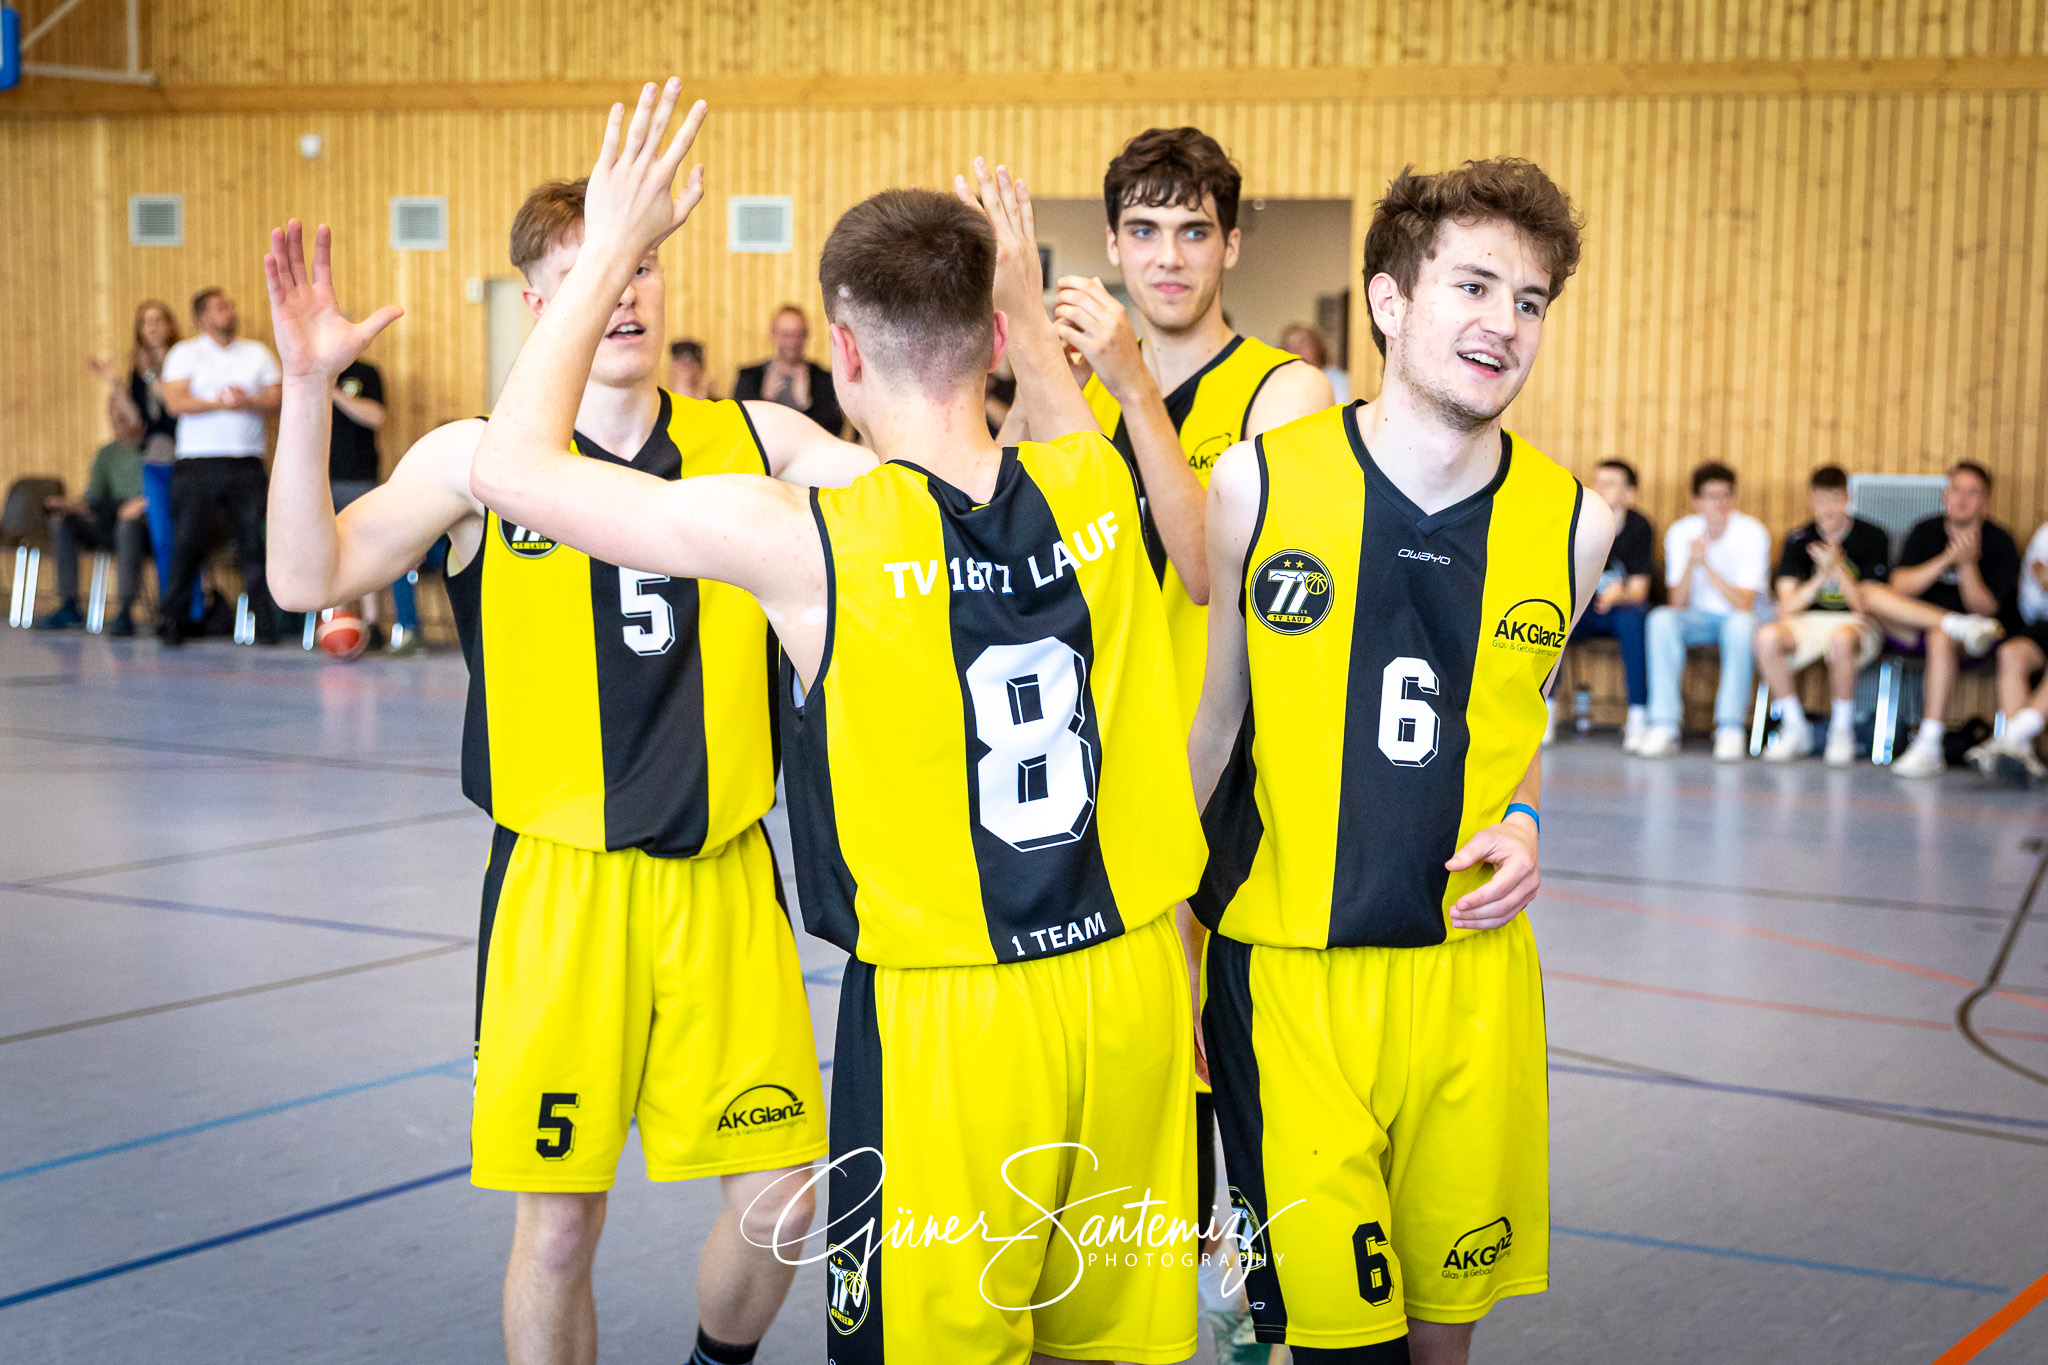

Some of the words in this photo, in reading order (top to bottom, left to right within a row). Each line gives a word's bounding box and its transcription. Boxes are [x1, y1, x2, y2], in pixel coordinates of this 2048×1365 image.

[884, 559, 938, 598] TV
[950, 557, 1014, 595] 1877
[1028, 510, 1119, 589] LAUF
[1398, 548, 1451, 566] owayo
[618, 566, 676, 657] 5
[1286, 615, 1308, 623] LAUF
[965, 635, 1096, 853] 8
[1377, 656, 1441, 768] 6
[1011, 935, 1026, 957] 1
[1030, 911, 1107, 953] TEAM
[535, 1092, 581, 1162] 5
[1352, 1220, 1395, 1308] 6
